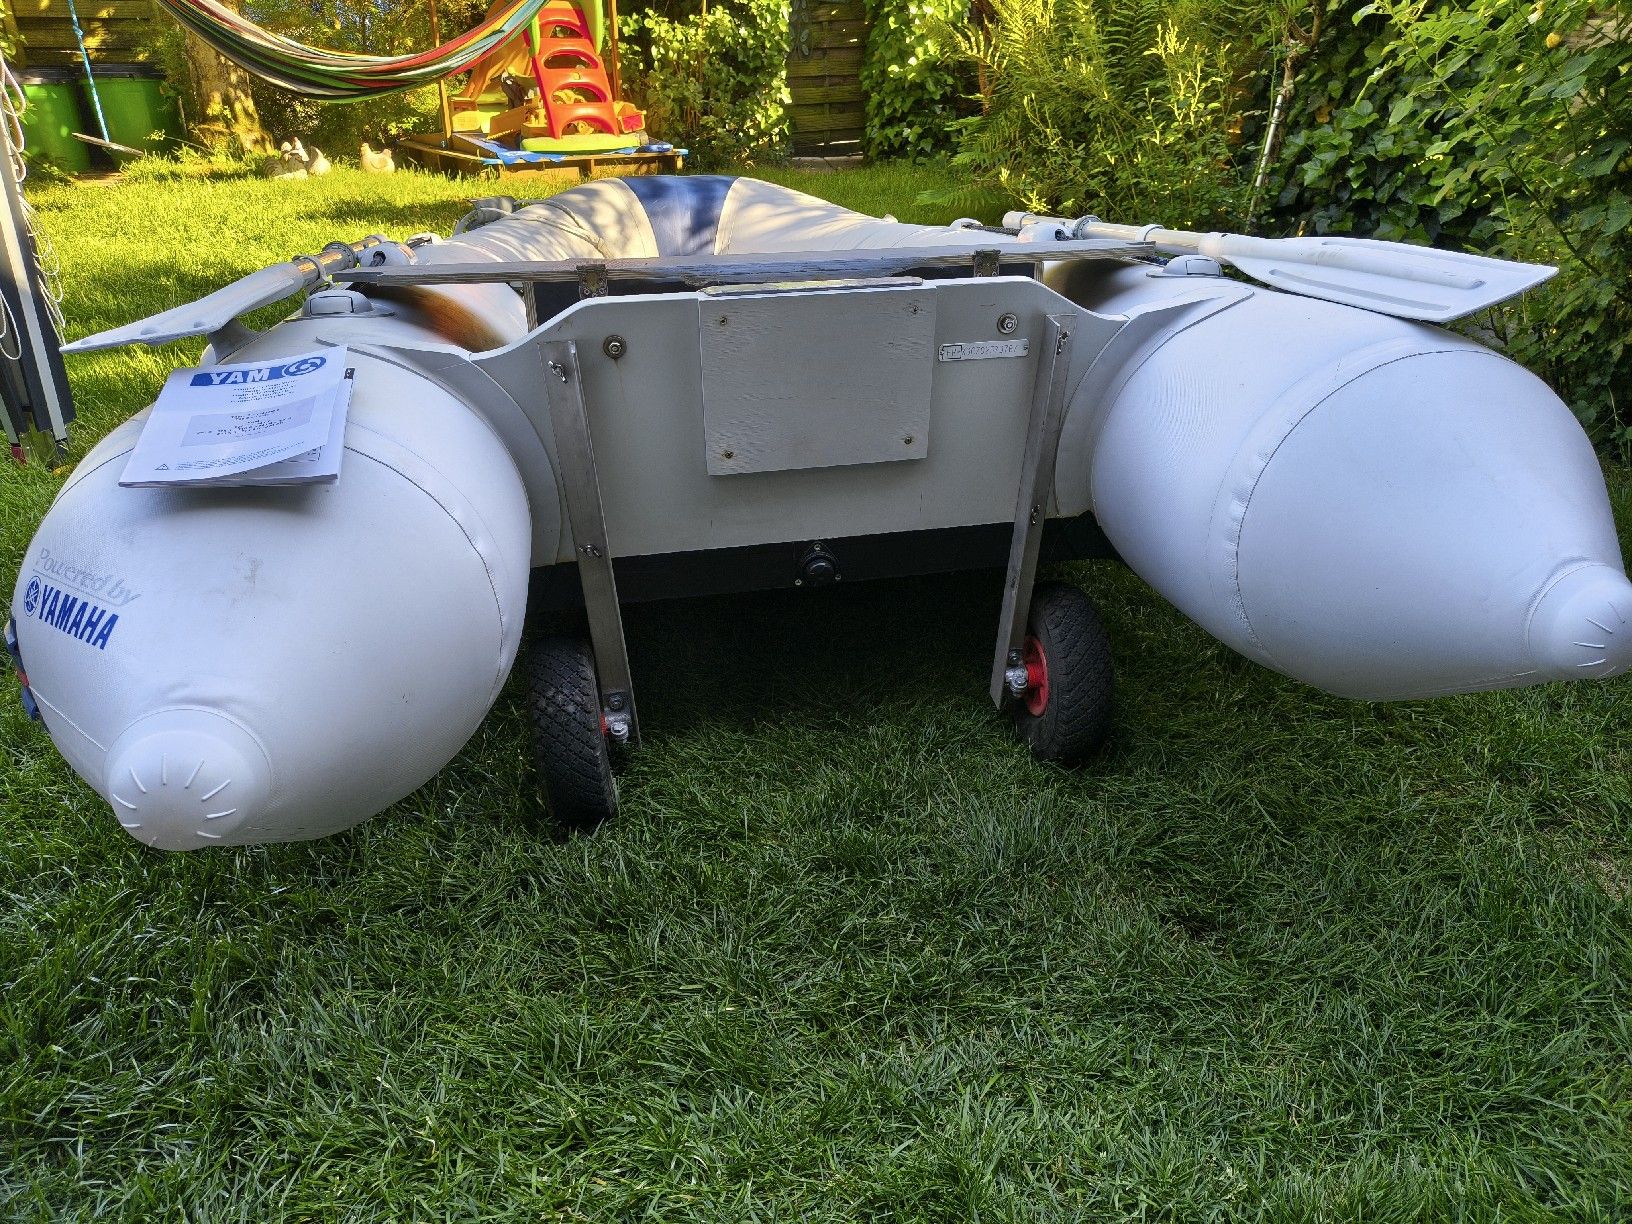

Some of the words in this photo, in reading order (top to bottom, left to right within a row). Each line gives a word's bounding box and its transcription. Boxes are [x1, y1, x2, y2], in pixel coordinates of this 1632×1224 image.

[210, 367, 271, 386] YAM
[35, 547, 113, 591] Powered
[106, 578, 141, 606] by
[38, 584, 119, 650] YAMAHA
